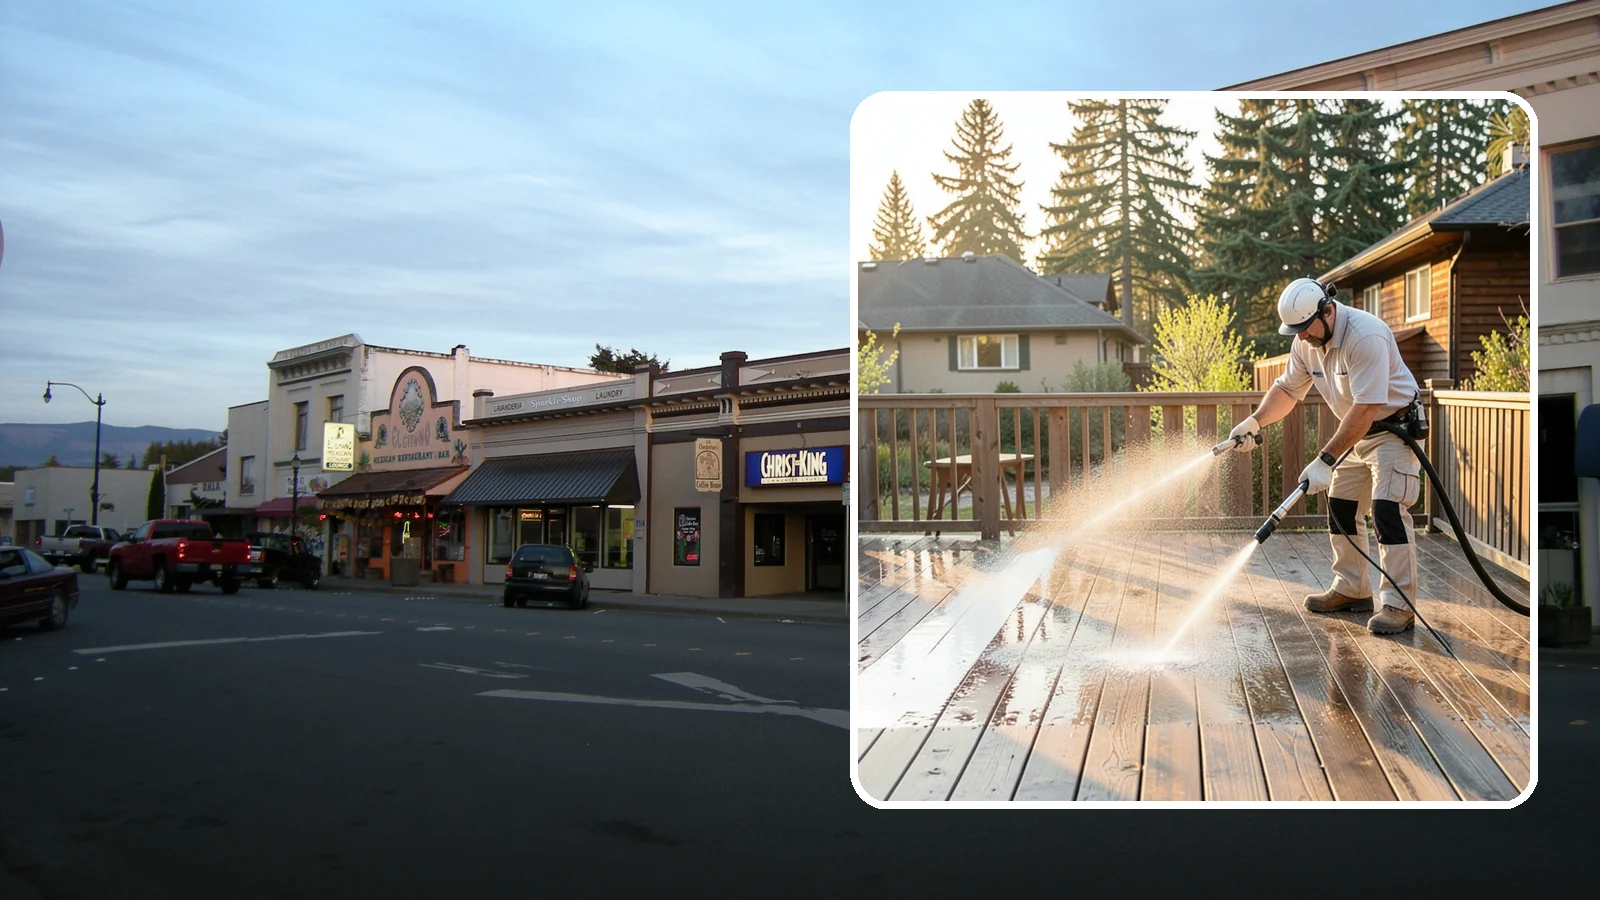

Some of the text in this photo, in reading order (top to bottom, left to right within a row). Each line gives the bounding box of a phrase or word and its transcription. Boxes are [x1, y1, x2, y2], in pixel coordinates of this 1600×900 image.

[493, 389, 624, 412] LAVANDERIA Sparkle Shop LAUNDRY
[373, 455, 396, 464] MEXICAN
[397, 451, 434, 462] RESTAURANT
[438, 450, 450, 458] BAR
[761, 450, 827, 478] CHRIST KING
